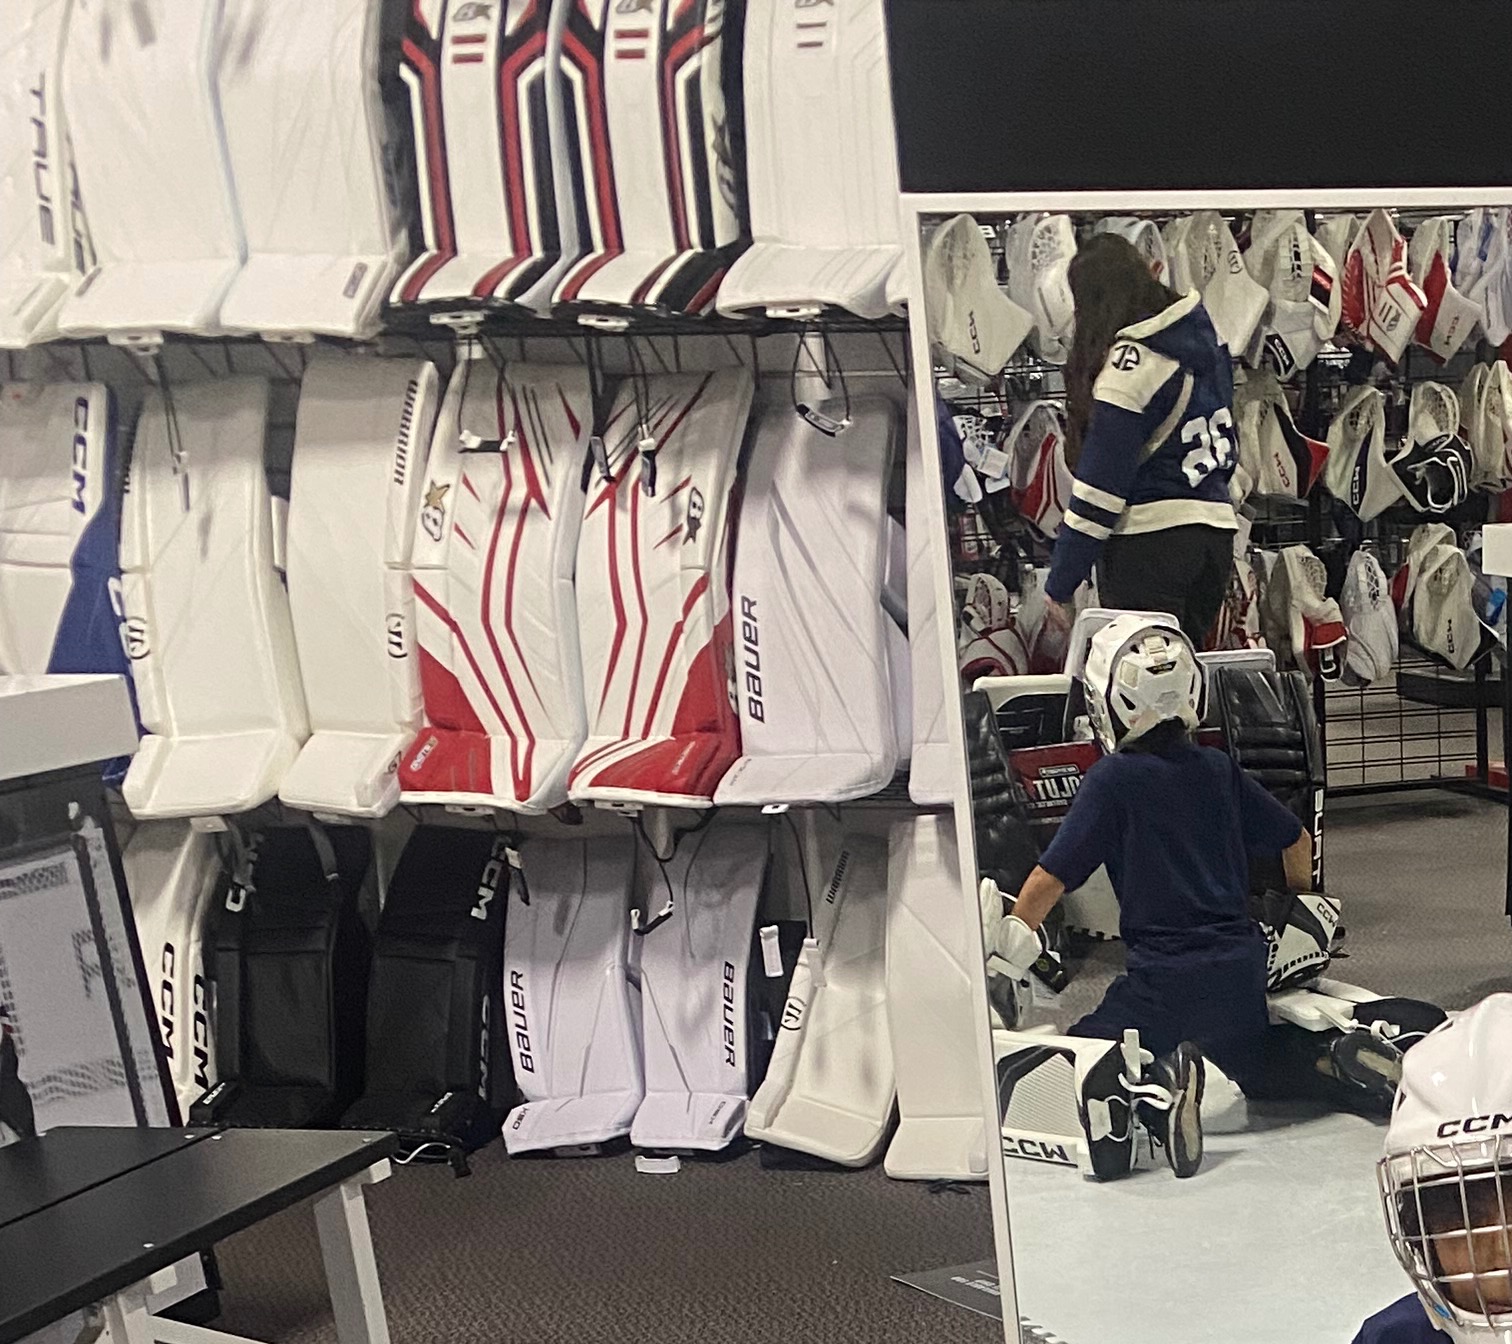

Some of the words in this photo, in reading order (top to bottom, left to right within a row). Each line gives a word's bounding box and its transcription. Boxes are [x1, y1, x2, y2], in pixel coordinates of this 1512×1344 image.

[72, 396, 88, 515] CCM
[740, 594, 766, 724] BAUER
[161, 942, 175, 1060] CCM
[193, 974, 210, 1091] CCM
[510, 969, 536, 1074] BAUER
[723, 960, 736, 1068] BAUER
